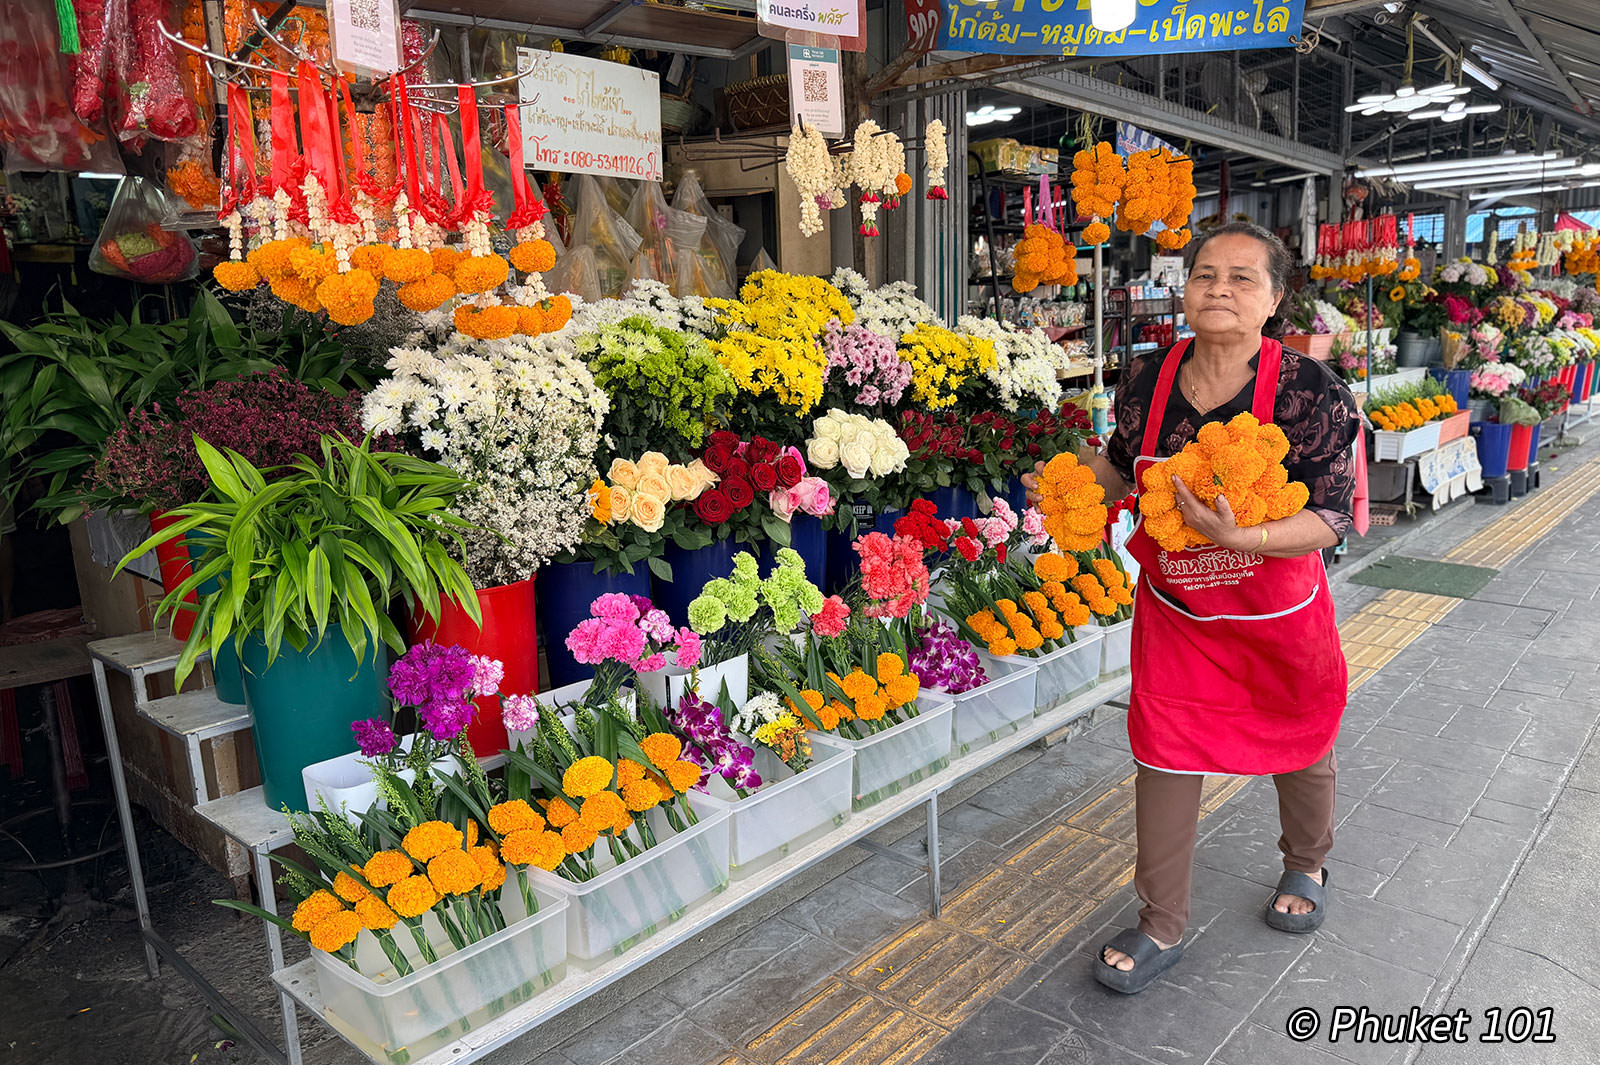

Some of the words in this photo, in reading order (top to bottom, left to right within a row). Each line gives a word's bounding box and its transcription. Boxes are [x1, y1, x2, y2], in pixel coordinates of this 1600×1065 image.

[769, 3, 816, 22] คนละครึ่ง
[817, 8, 849, 25] พลัส
